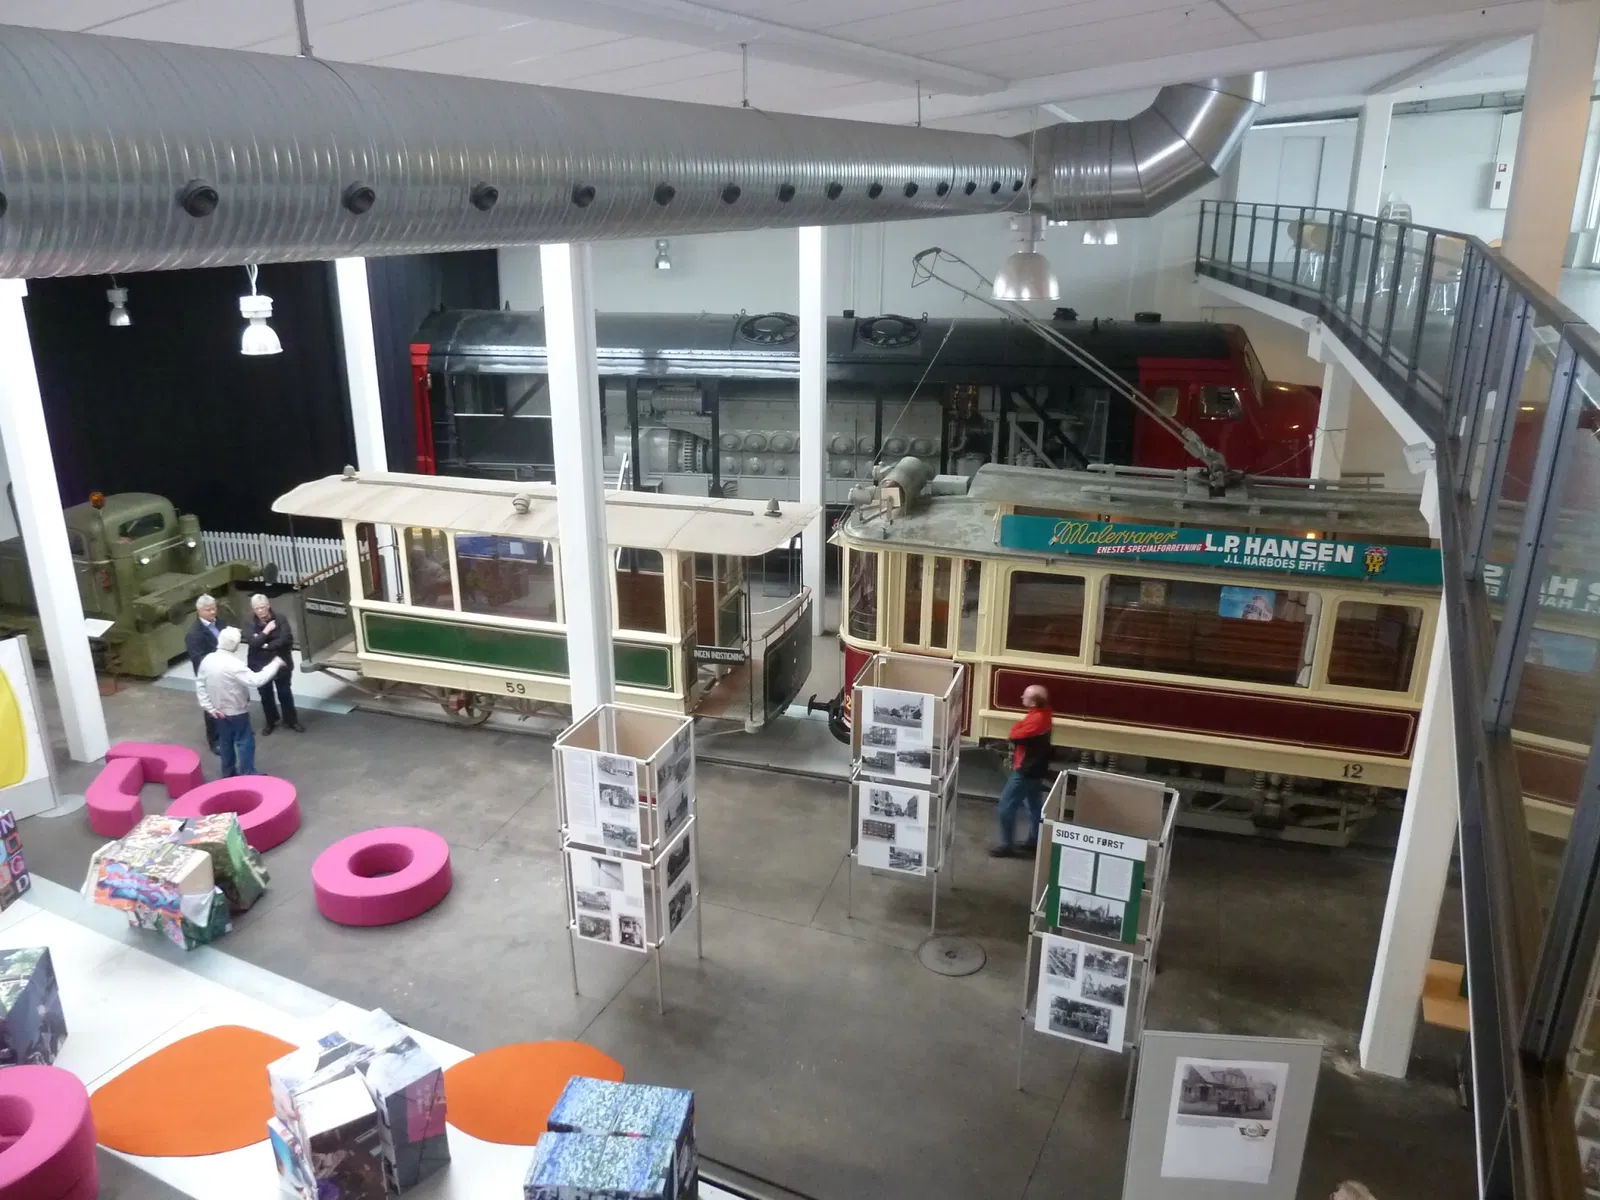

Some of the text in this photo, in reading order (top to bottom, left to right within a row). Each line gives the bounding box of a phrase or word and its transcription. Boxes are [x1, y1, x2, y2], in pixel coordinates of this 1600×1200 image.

[1096, 543, 1202, 554] ENESTE SPECIALFORRETNING
[1244, 536, 1355, 563] HANSEN
[505, 681, 526, 695] 59
[1342, 763, 1364, 778] 12
[1056, 828, 1081, 841] SIDST
[1096, 837, 1125, 850] FØRST
